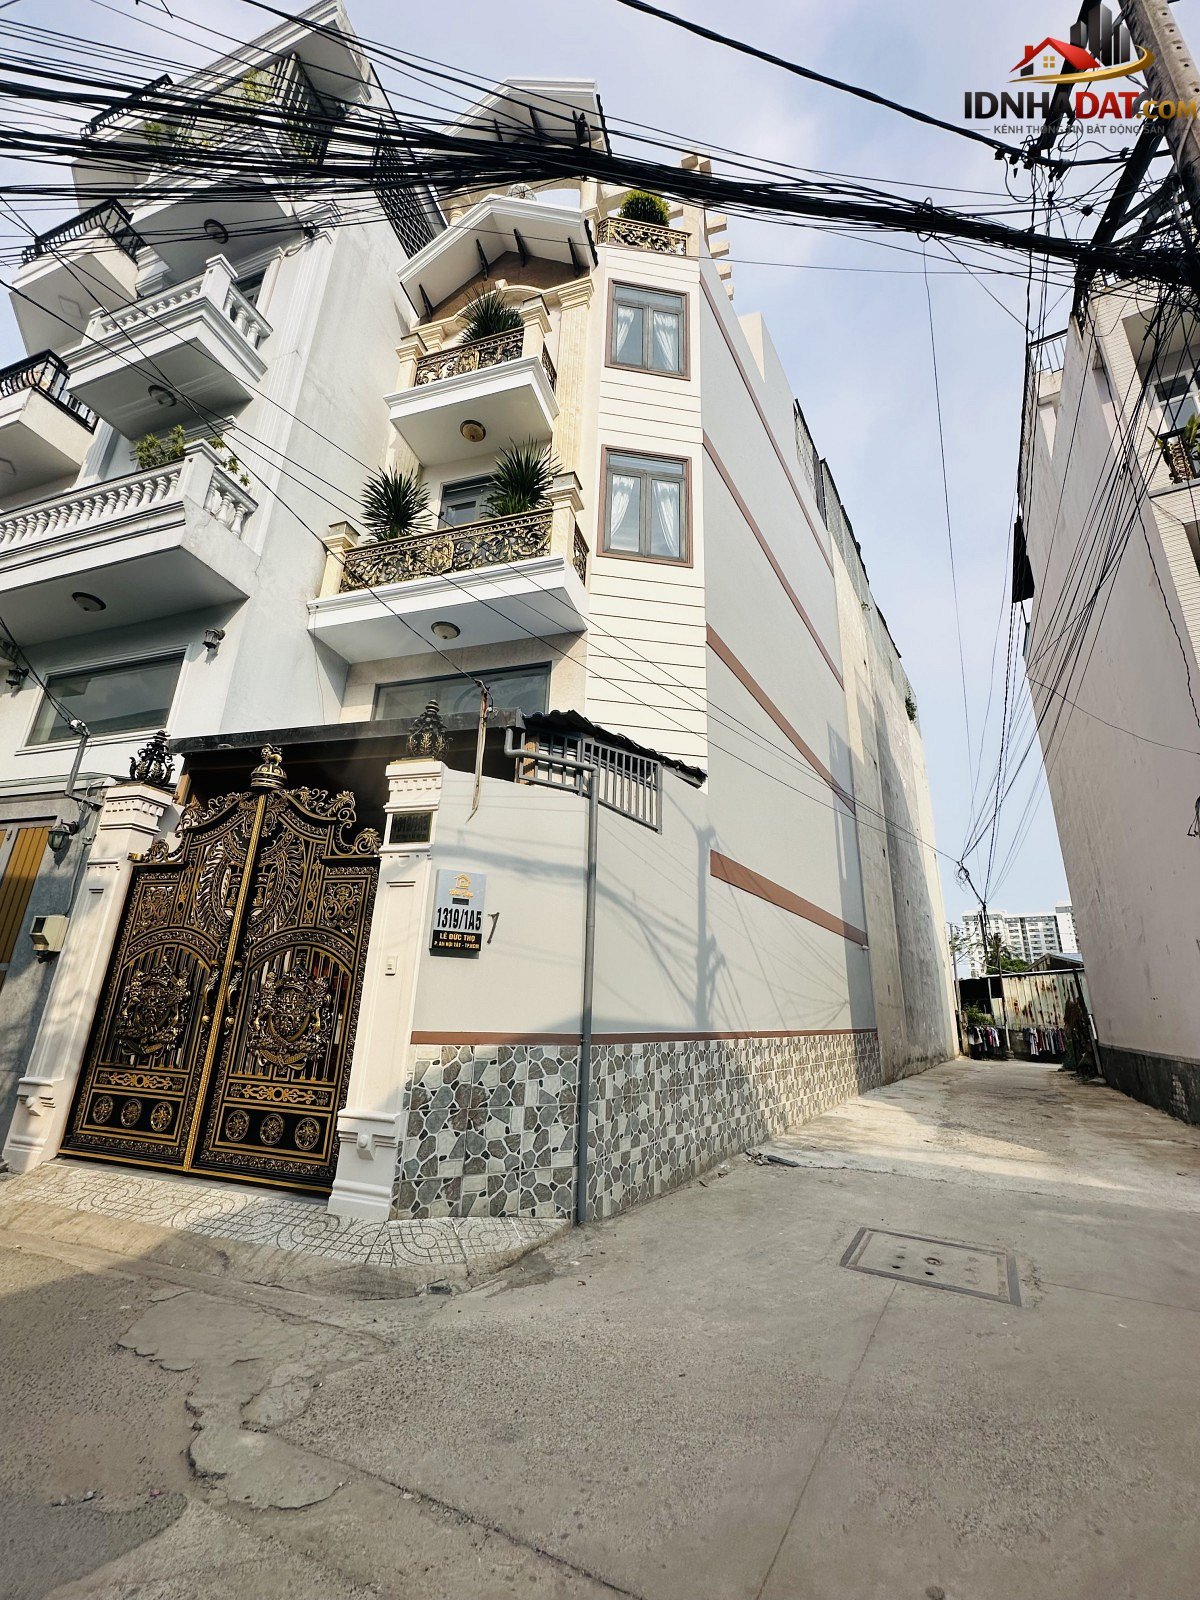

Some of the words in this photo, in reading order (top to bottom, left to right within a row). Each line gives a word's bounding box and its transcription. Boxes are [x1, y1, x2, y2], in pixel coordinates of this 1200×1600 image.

[437, 907, 482, 930] 1319/1A5
[439, 932, 448, 940] LÊ
[448, 933, 462, 941] ĐỨC
